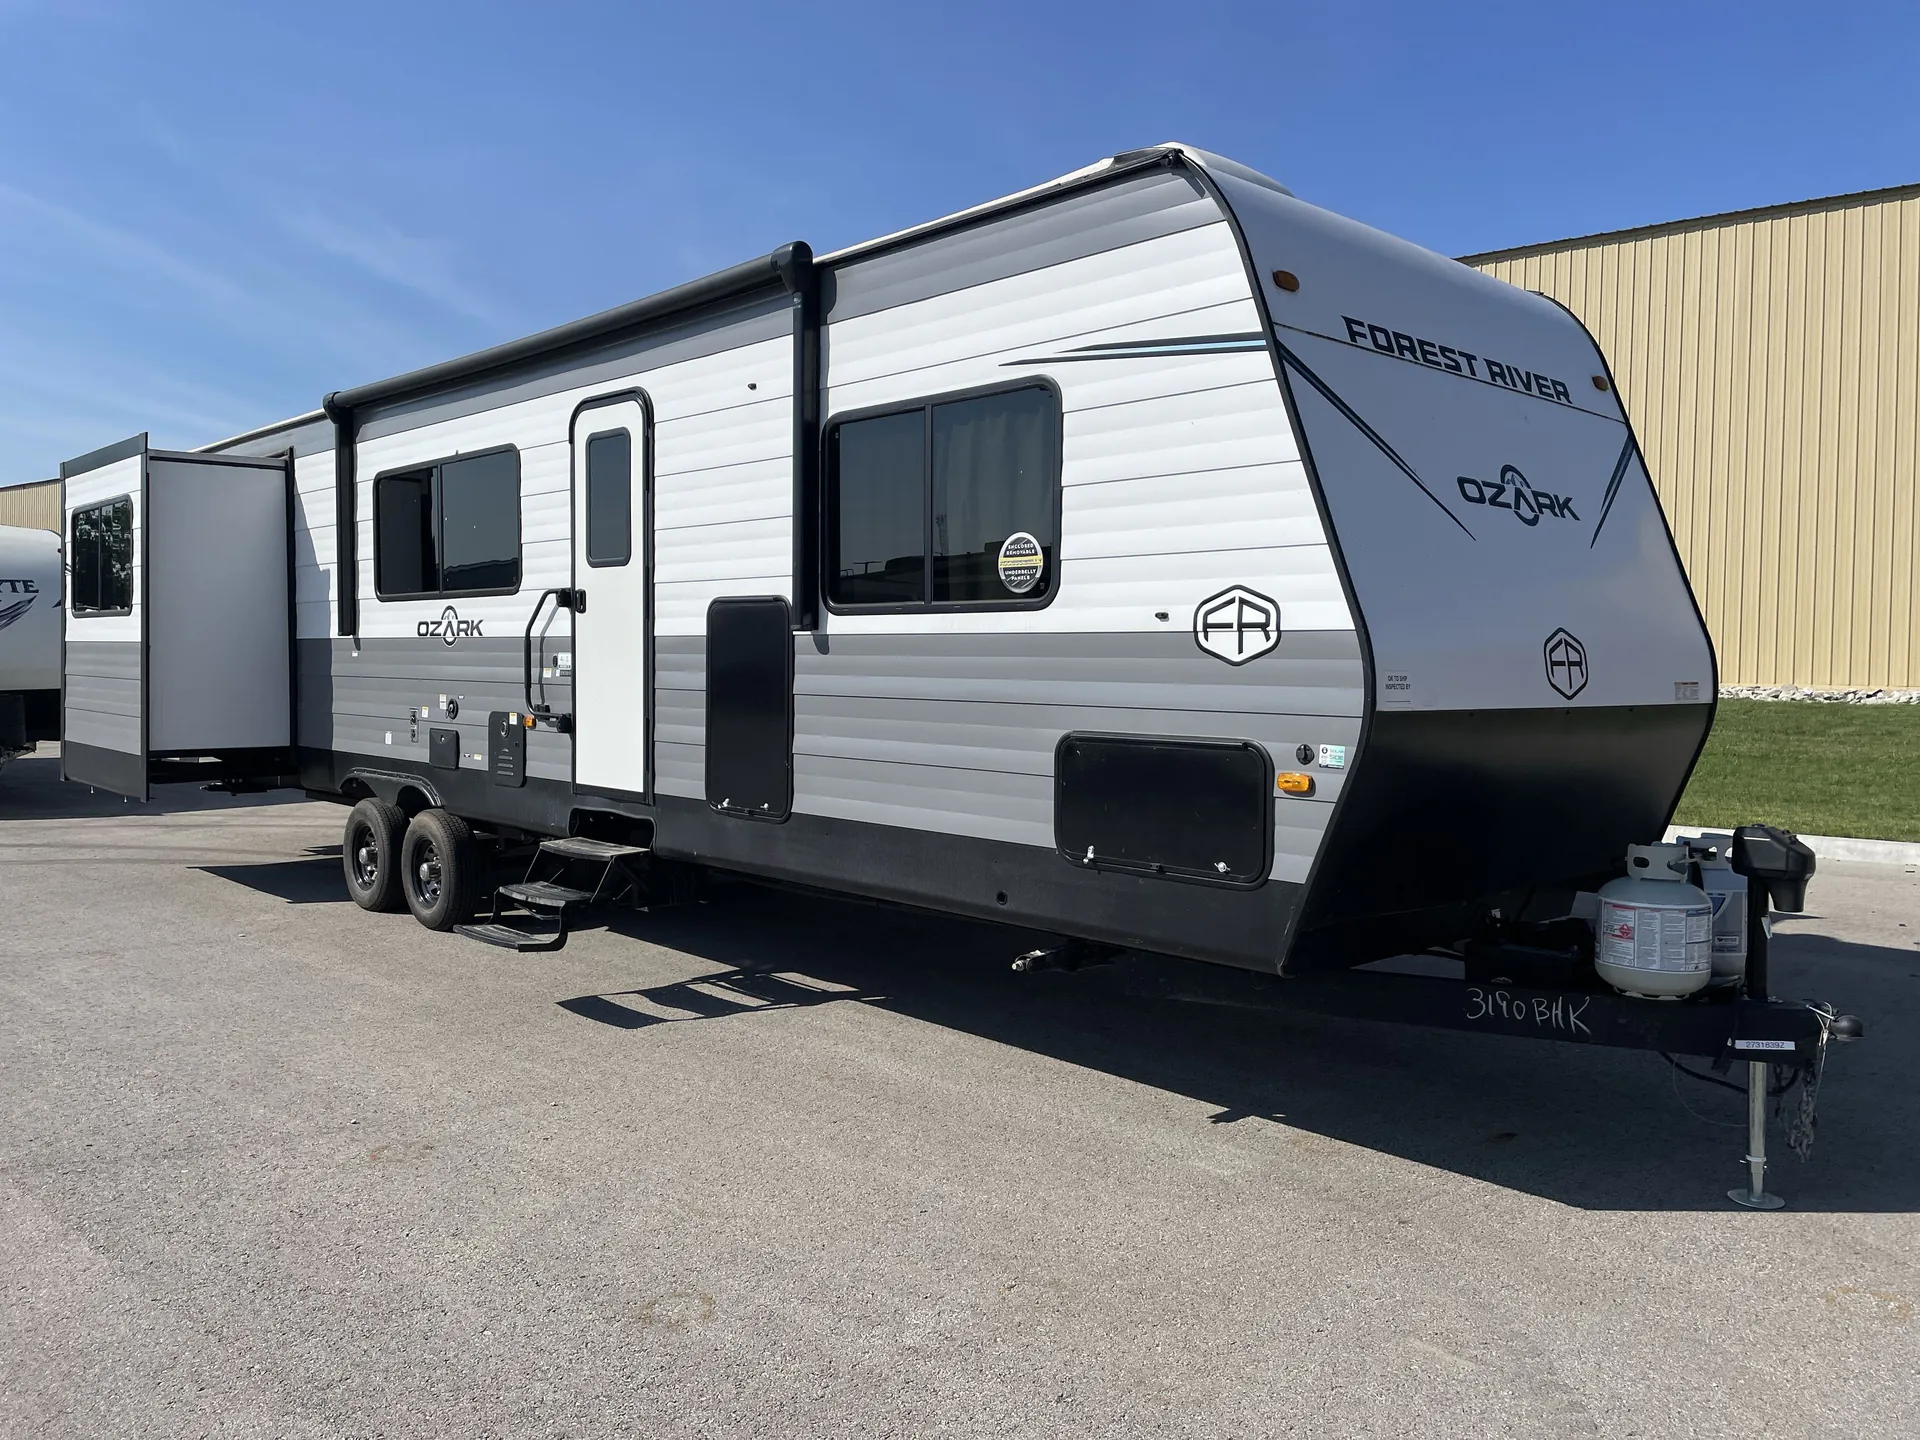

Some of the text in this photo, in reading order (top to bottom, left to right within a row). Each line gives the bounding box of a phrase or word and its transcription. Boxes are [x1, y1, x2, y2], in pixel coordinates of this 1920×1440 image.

[1340, 315, 1573, 404] FOREST RIVER
[1456, 475, 1581, 522] OZARK
[417, 619, 484, 637] OZARK
